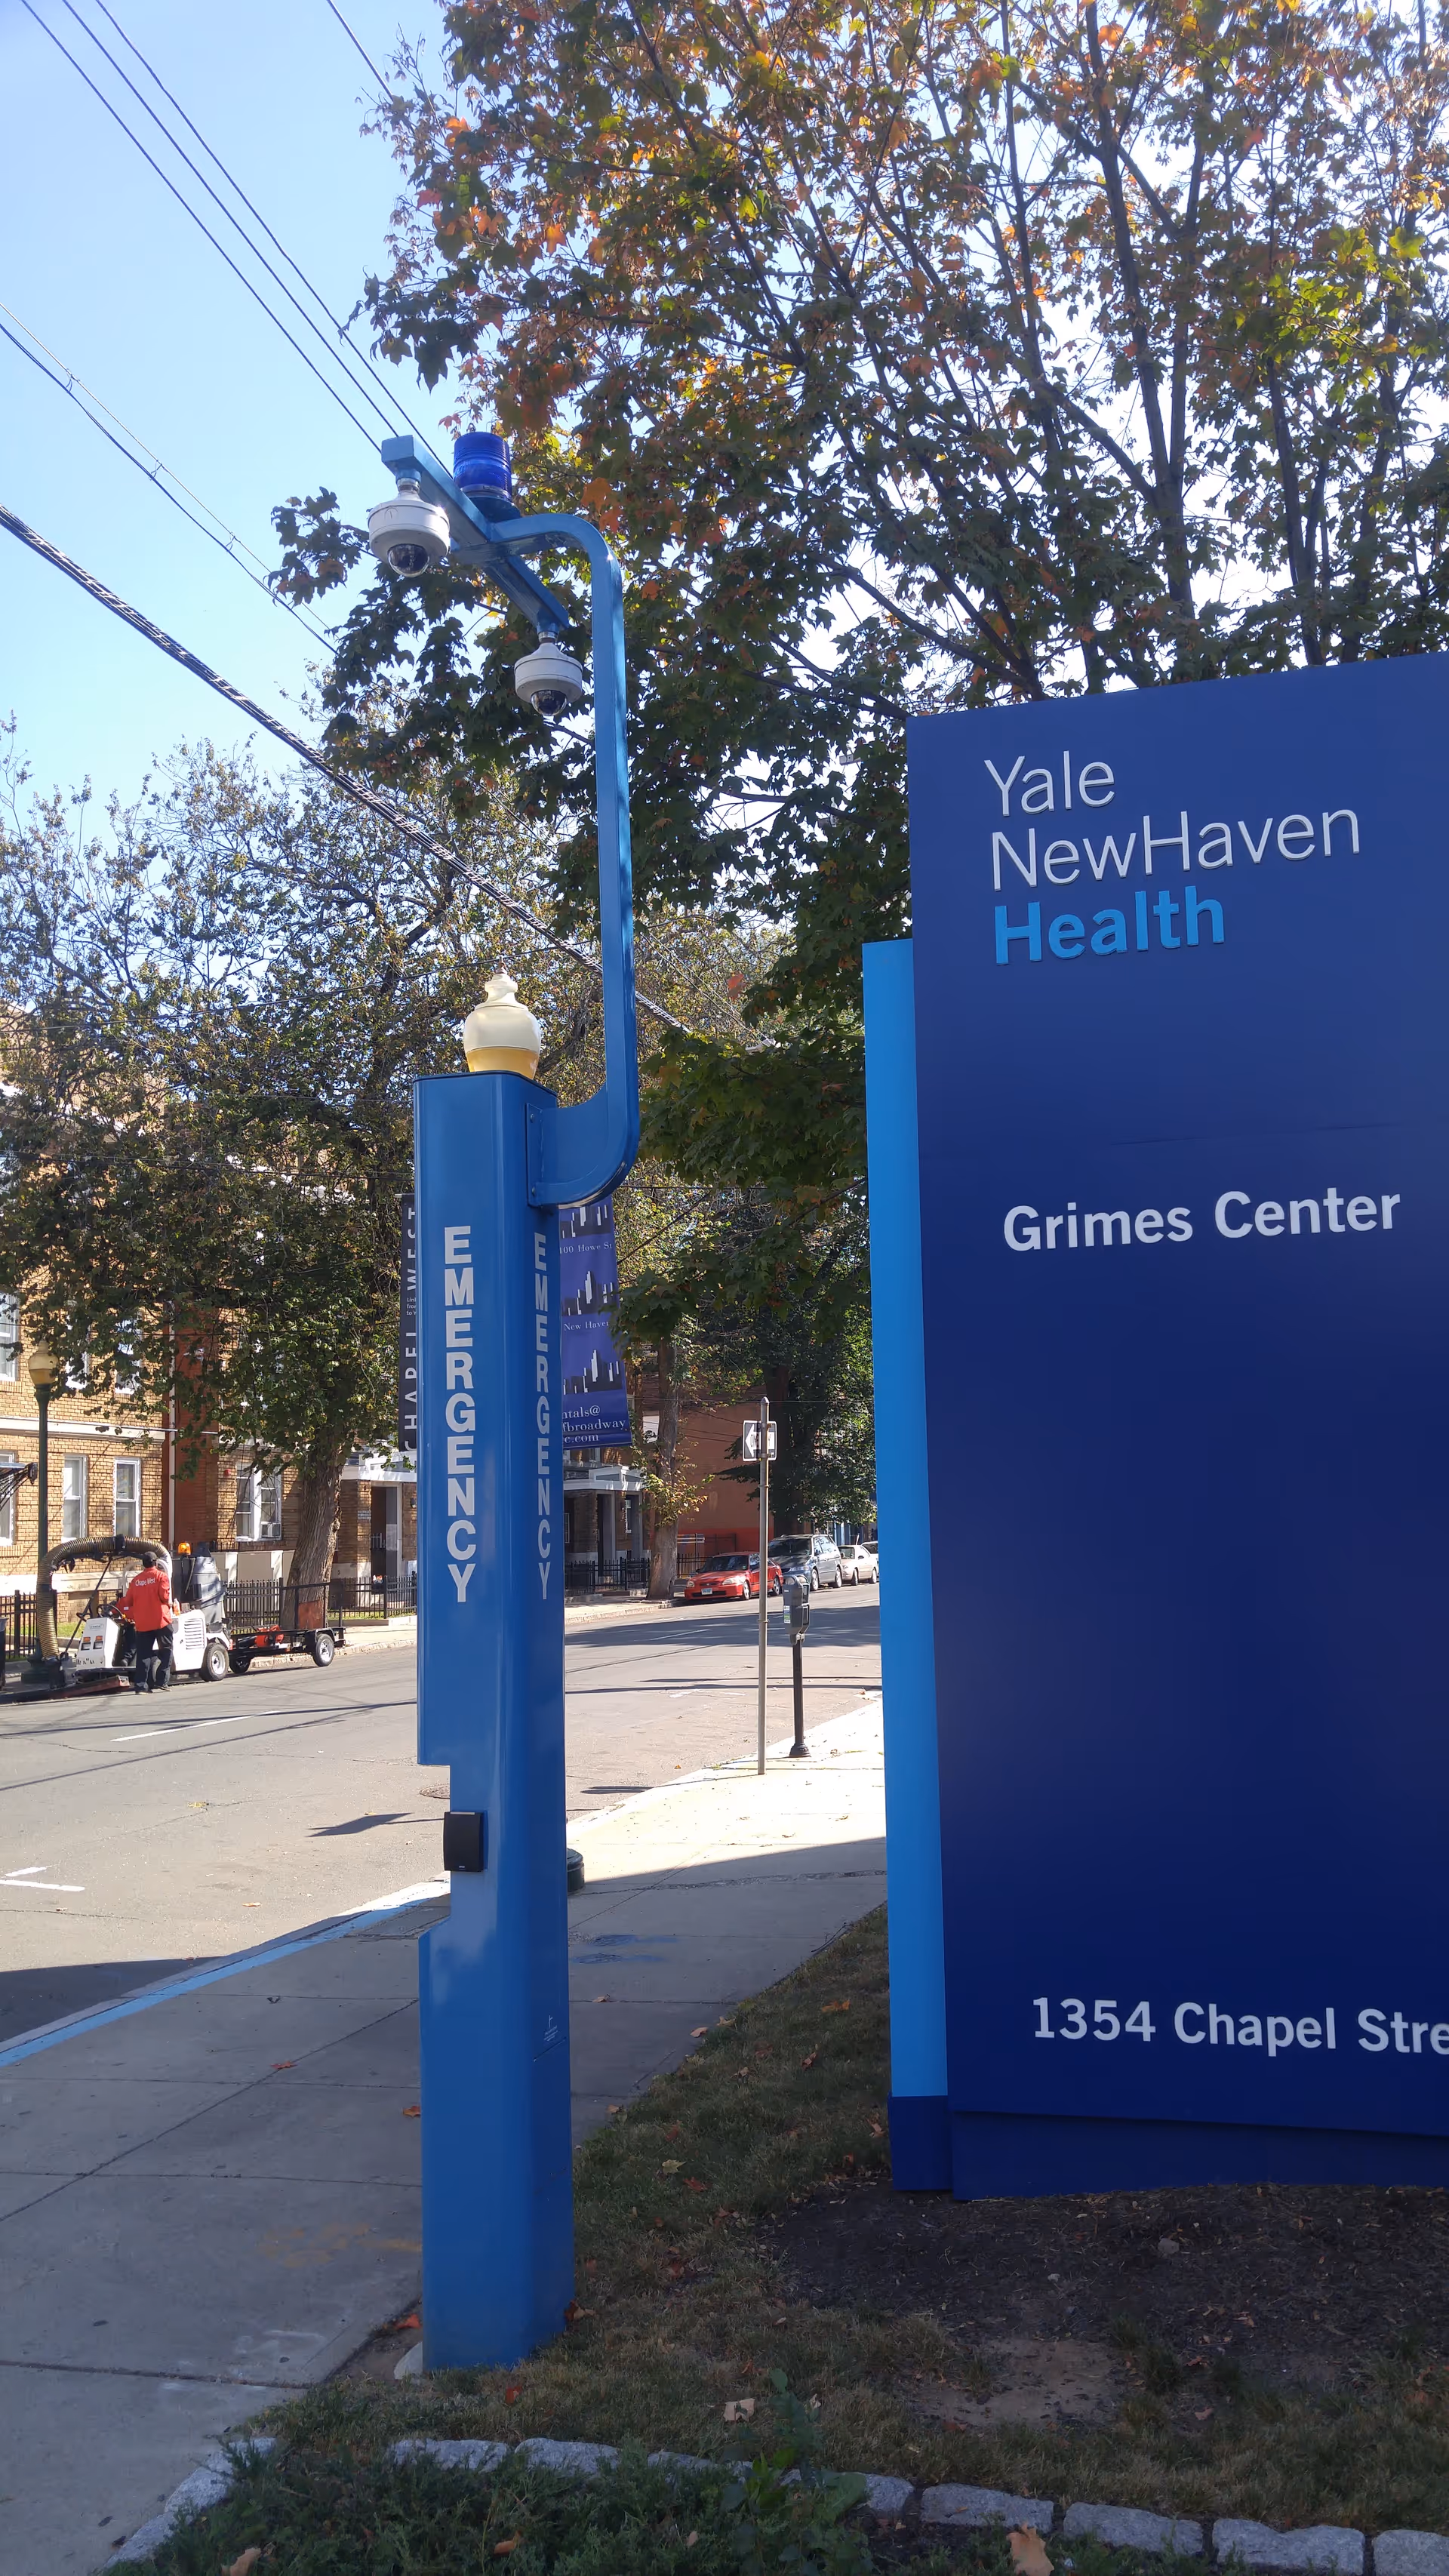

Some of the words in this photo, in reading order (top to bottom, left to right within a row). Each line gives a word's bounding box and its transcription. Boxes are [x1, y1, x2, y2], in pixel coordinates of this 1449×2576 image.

[984, 750, 1115, 817] Yale
[992, 808, 1360, 891] NewHaven
[994, 885, 1224, 965] Health
[1004, 1202, 1193, 1251] Grimes
[1214, 1187, 1401, 1238] Center
[564, 1322, 582, 1331] New
[444, 1226, 476, 1603] EMERGENCY
[534, 1232, 551, 1600] EMERGENCY
[1032, 1997, 1156, 2042] 1354
[1174, 2002, 1337, 2057] Chapel
